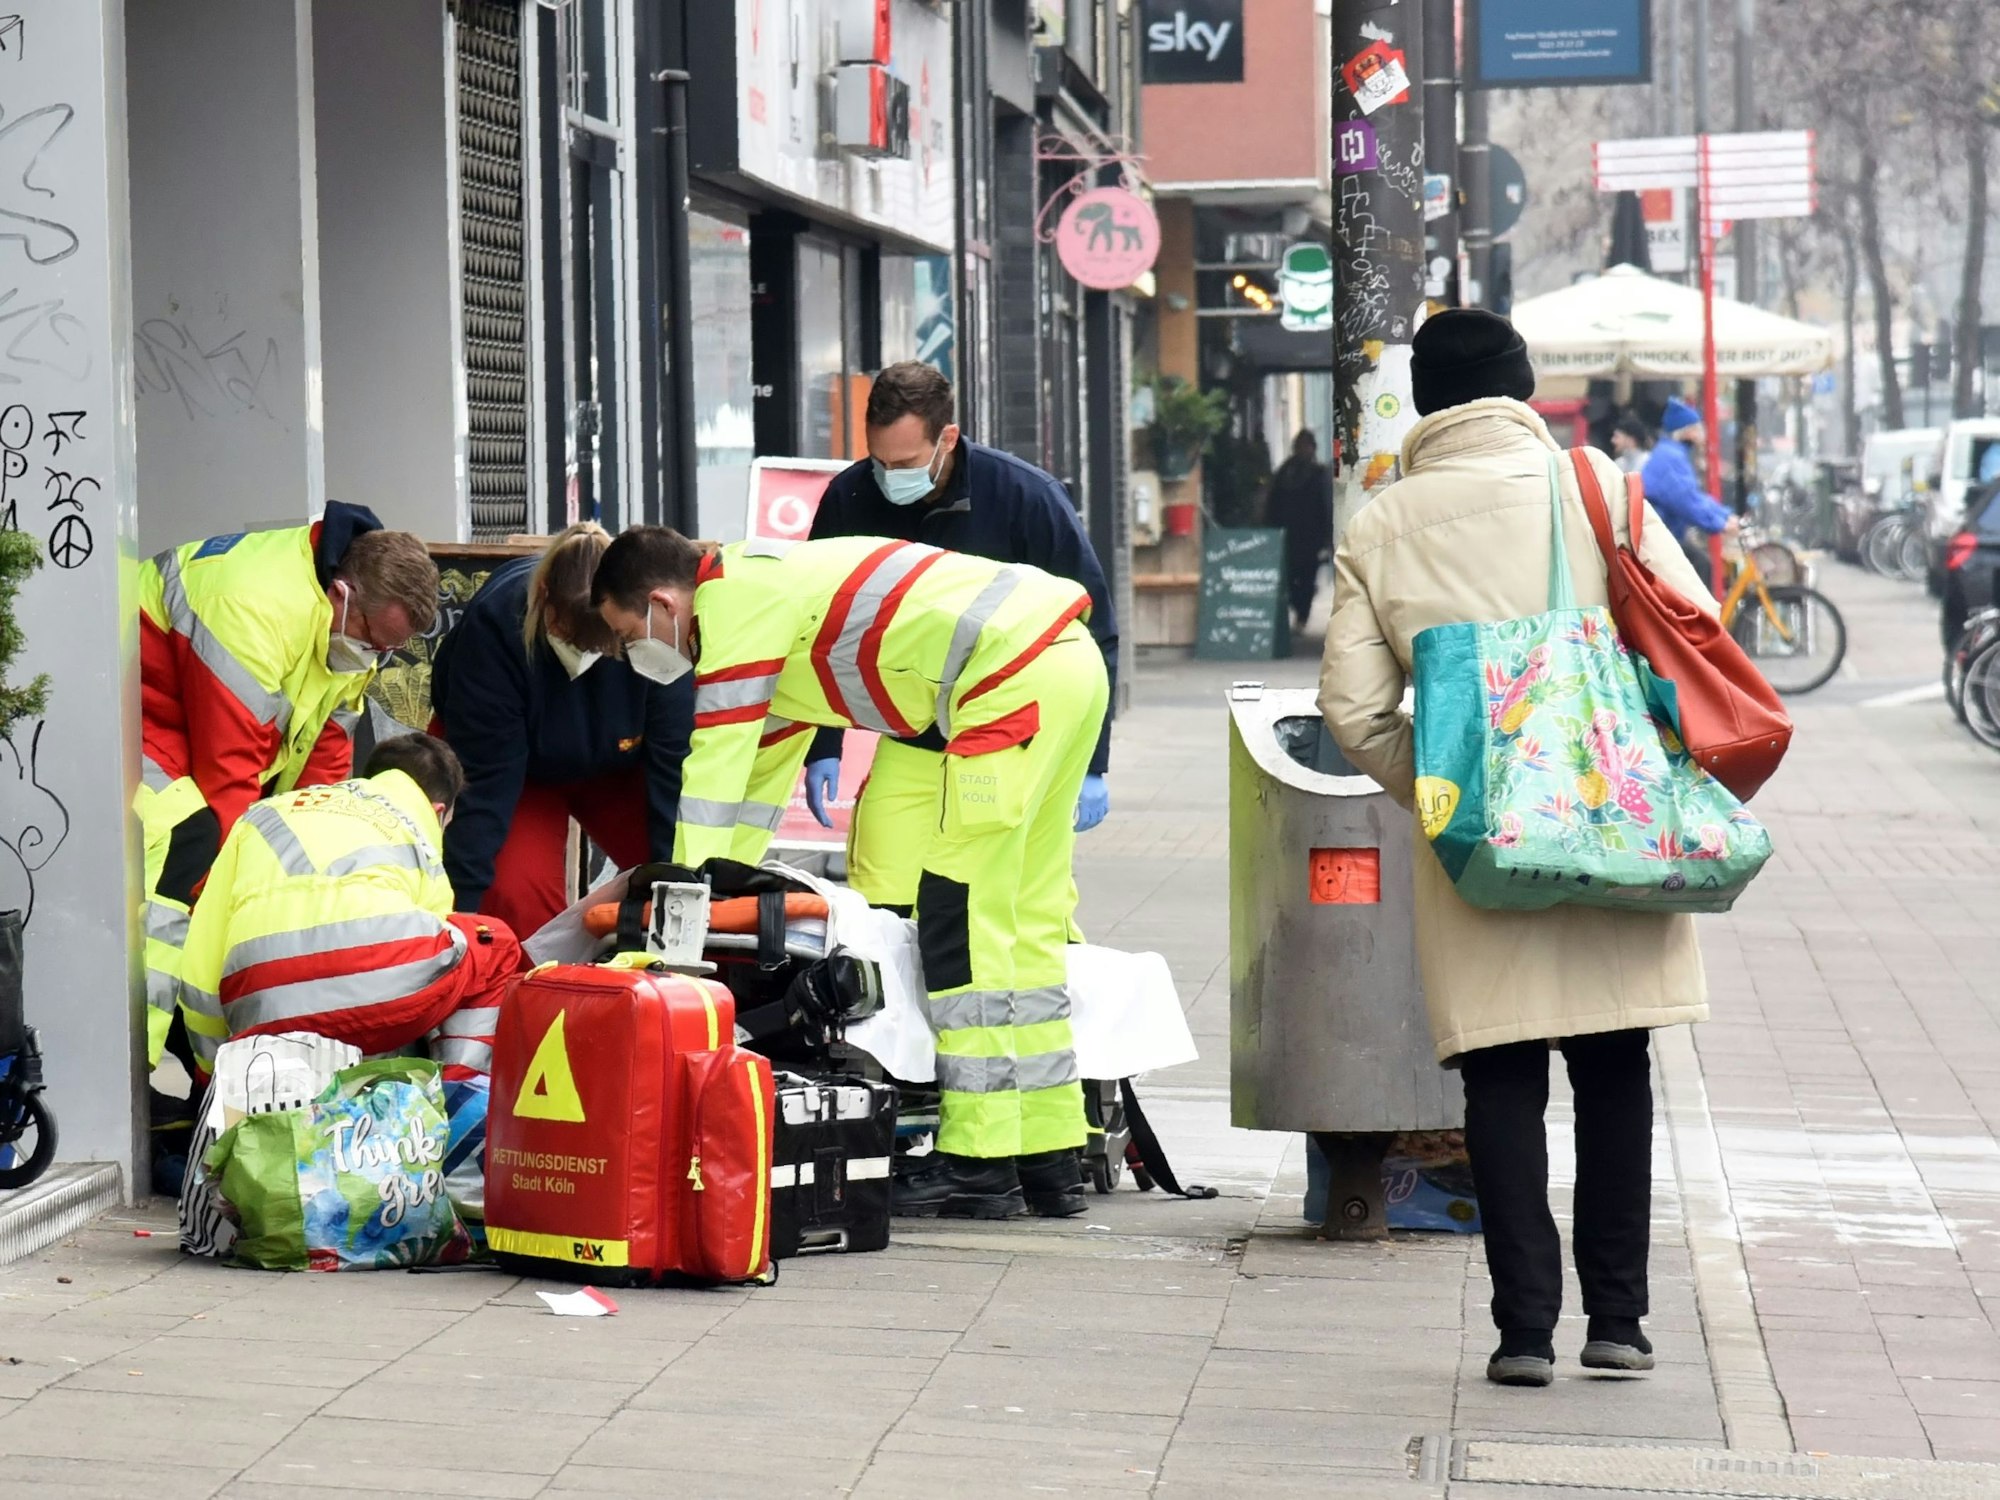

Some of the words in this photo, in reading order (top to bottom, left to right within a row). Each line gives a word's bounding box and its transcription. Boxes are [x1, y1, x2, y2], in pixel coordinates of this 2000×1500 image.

[1148, 10, 1232, 61] sky
[959, 773, 998, 786] STADT
[323, 1112, 444, 1173] Think
[492, 1147, 609, 1175] RETTUNGSDIENST
[512, 1172, 541, 1192] Stadt
[545, 1175, 576, 1195] Köln
[573, 1240, 605, 1263] PAX
